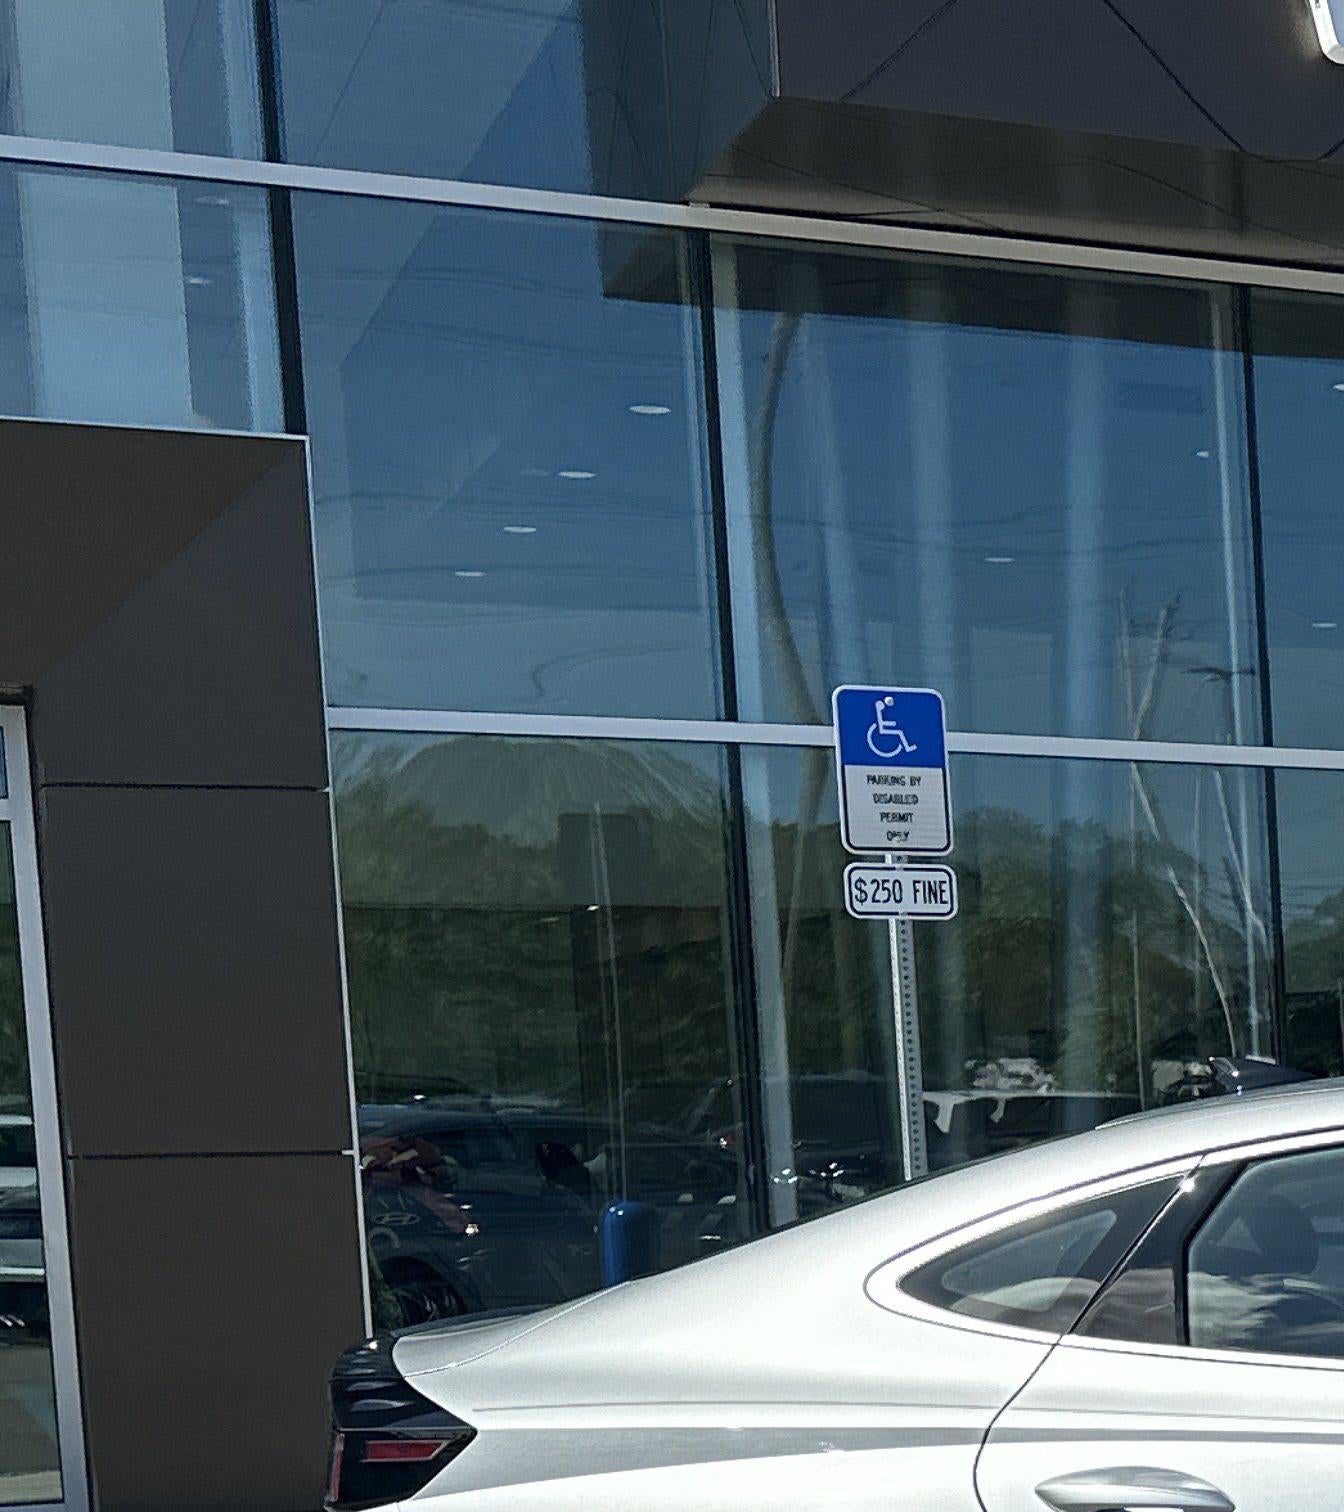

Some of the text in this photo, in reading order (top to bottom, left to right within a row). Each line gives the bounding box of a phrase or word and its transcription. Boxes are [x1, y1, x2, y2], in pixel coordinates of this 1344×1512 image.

[866, 774, 922, 787] PARKING BY
[872, 792, 919, 805] DISABLED
[879, 812, 914, 823] PERMIT
[854, 877, 949, 906] $250 FINE
